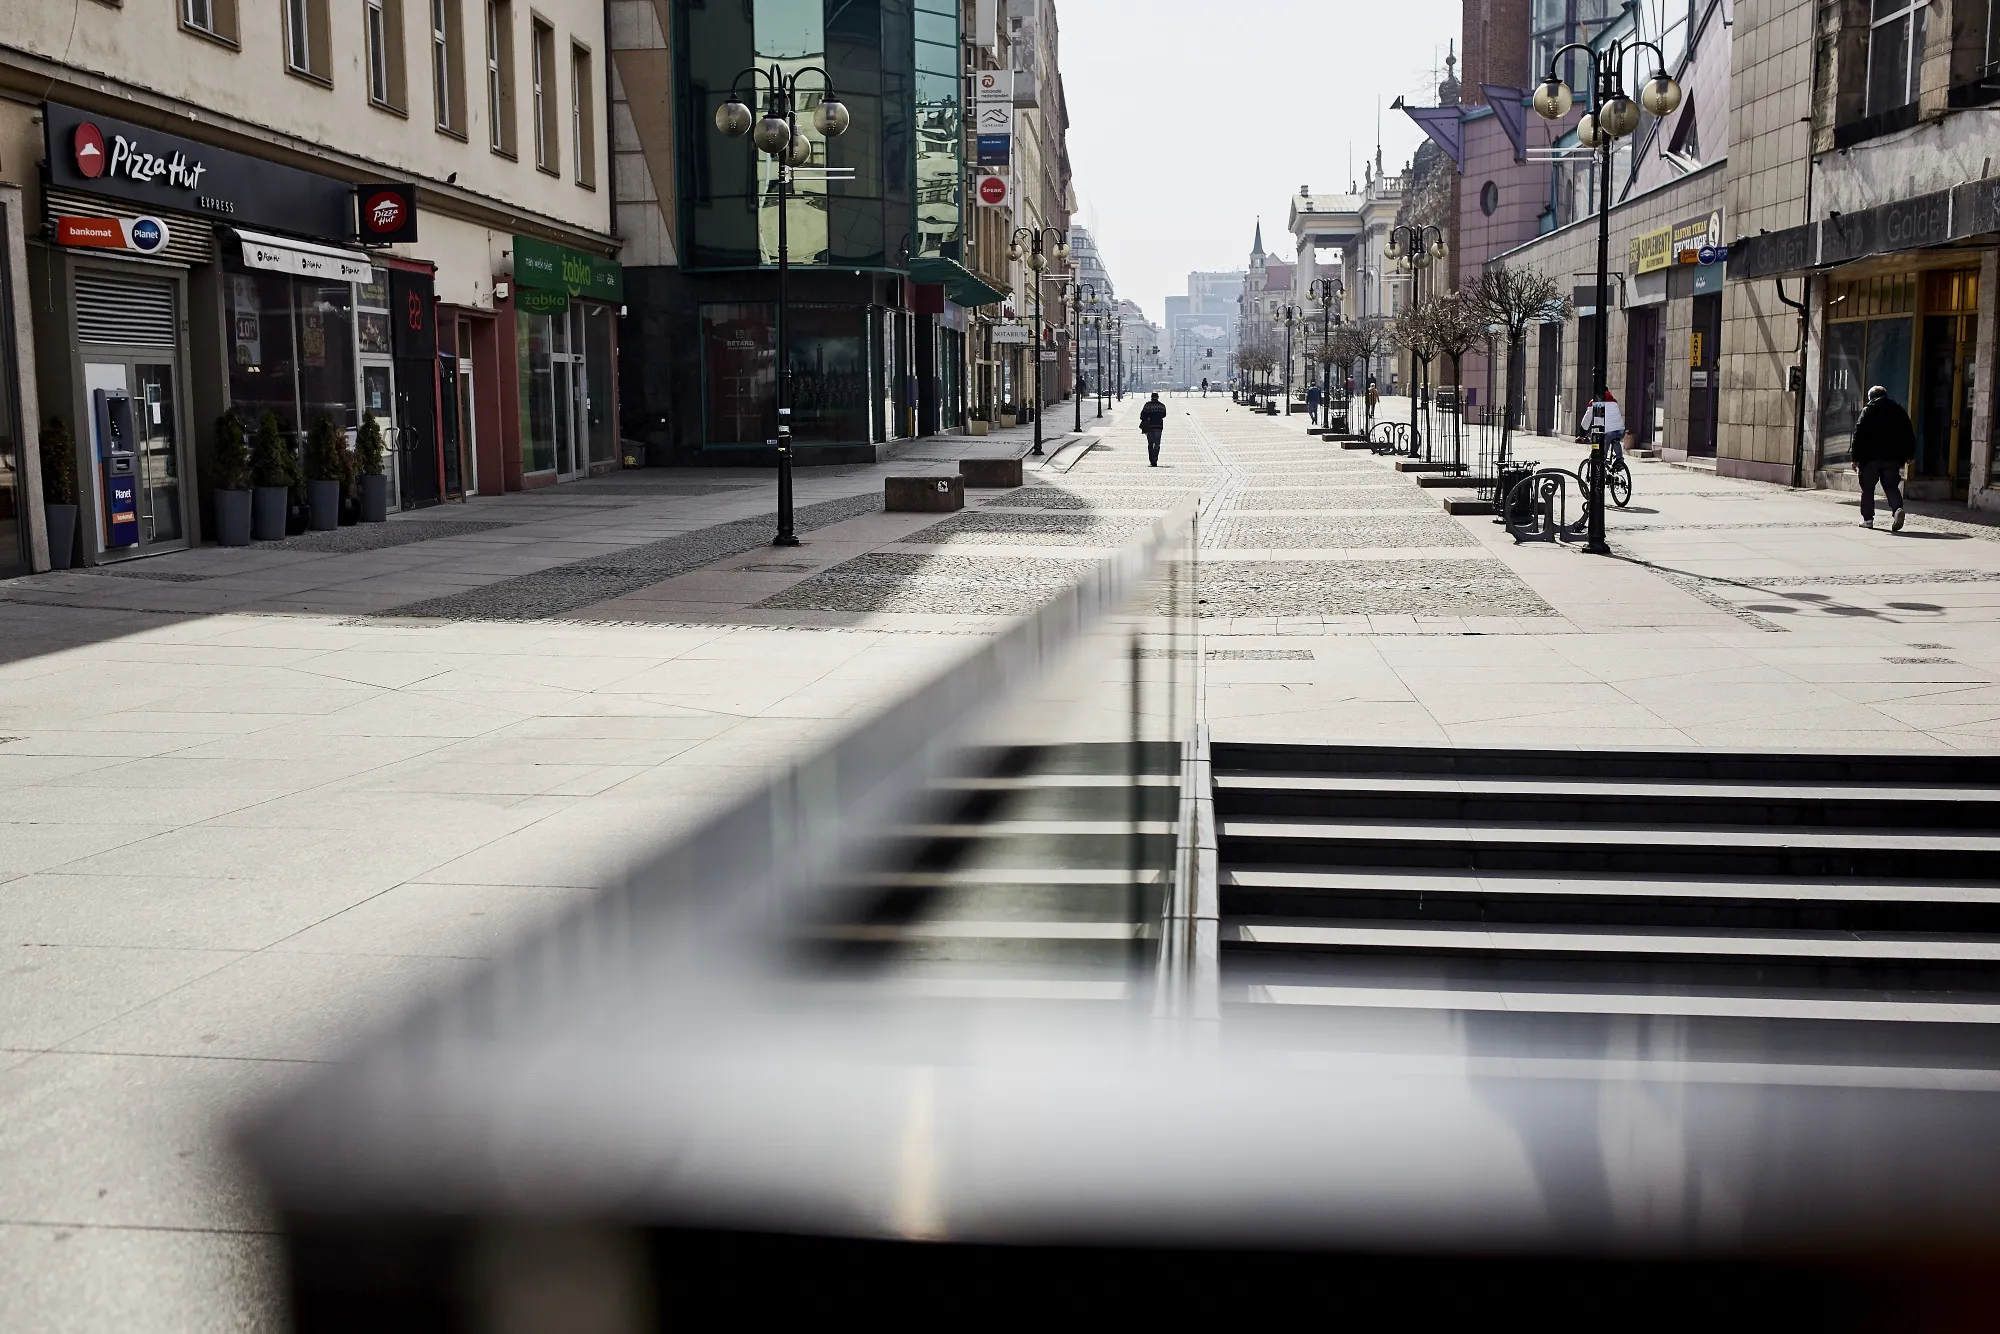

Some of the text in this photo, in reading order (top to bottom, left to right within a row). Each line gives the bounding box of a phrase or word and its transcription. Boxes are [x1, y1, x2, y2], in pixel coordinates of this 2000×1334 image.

[110, 135, 207, 190] Pizza Hut
[201, 196, 234, 213] EXPRESS
[373, 208, 399, 221] Pizza
[378, 215, 396, 226] Hut
[69, 226, 159, 240] bankomat Planet
[1674, 225, 1692, 240] KANTOR
[562, 254, 591, 286] żabka
[525, 293, 565, 306] żabka
[115, 489, 131, 499] Planet
